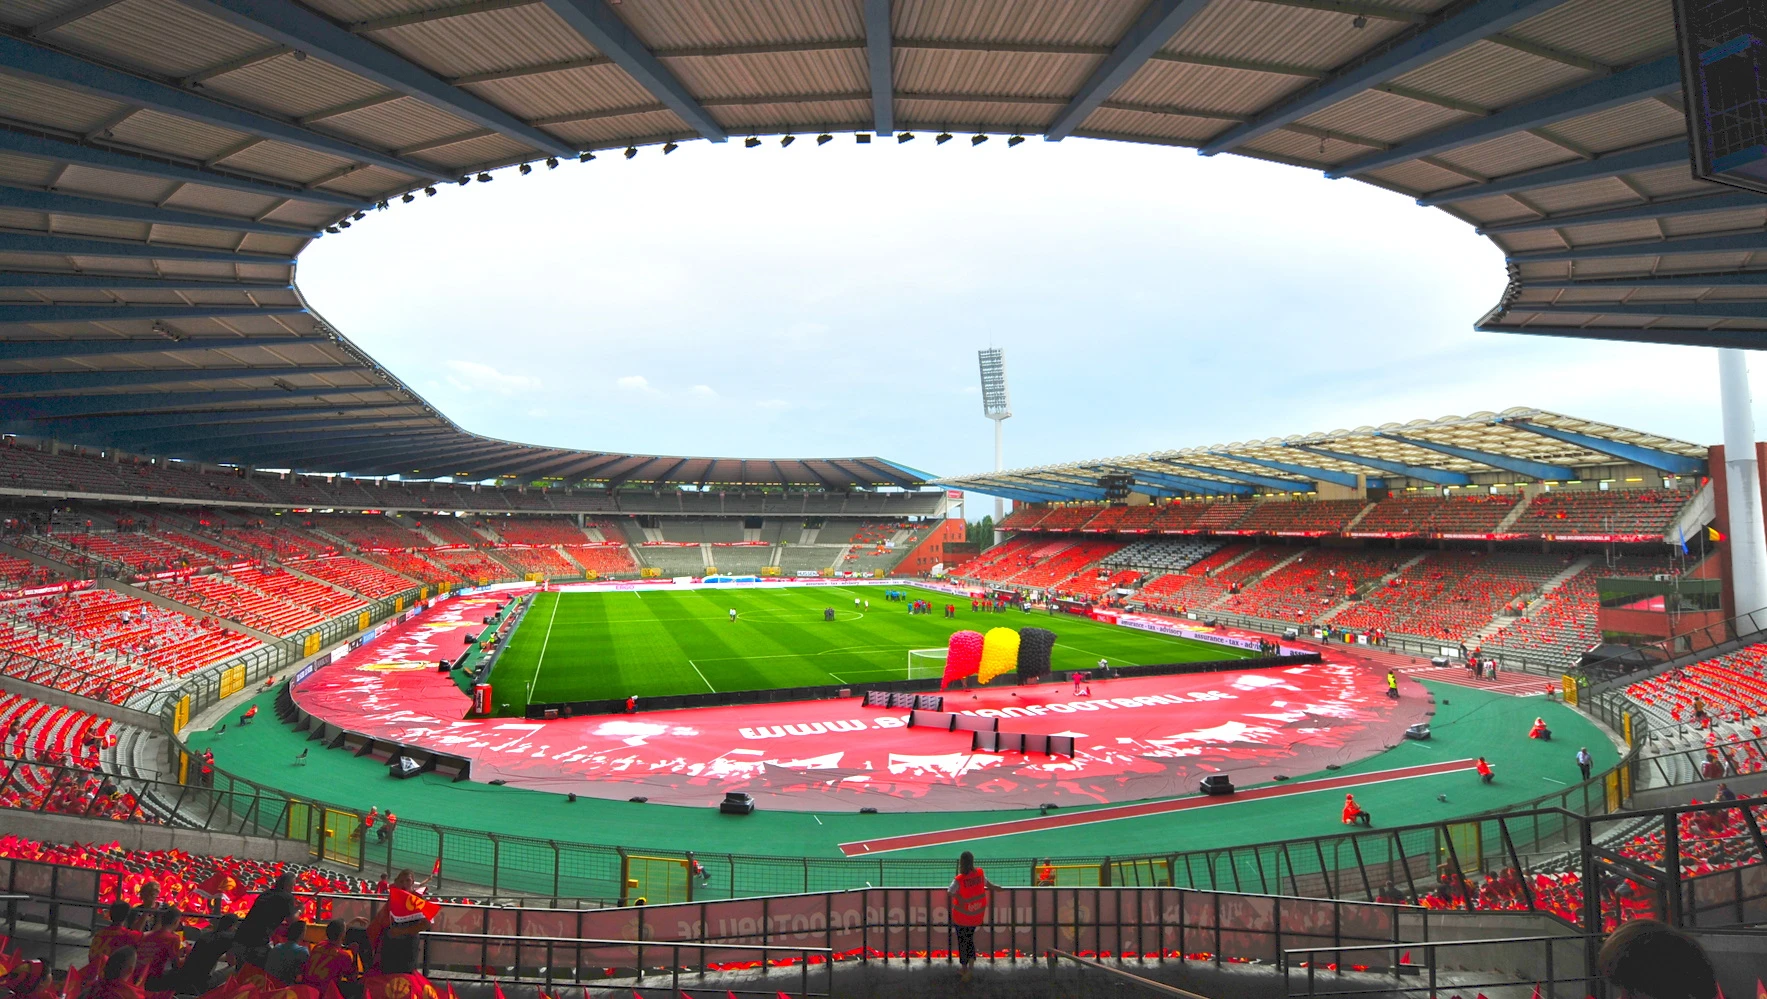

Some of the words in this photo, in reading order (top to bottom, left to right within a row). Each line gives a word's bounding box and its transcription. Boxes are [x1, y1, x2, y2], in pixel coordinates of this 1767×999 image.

[1121, 620, 1144, 629] assurance
[1159, 626, 1183, 637] advisory
[1194, 633, 1225, 645] assurance
[1228, 638, 1239, 647] tax
